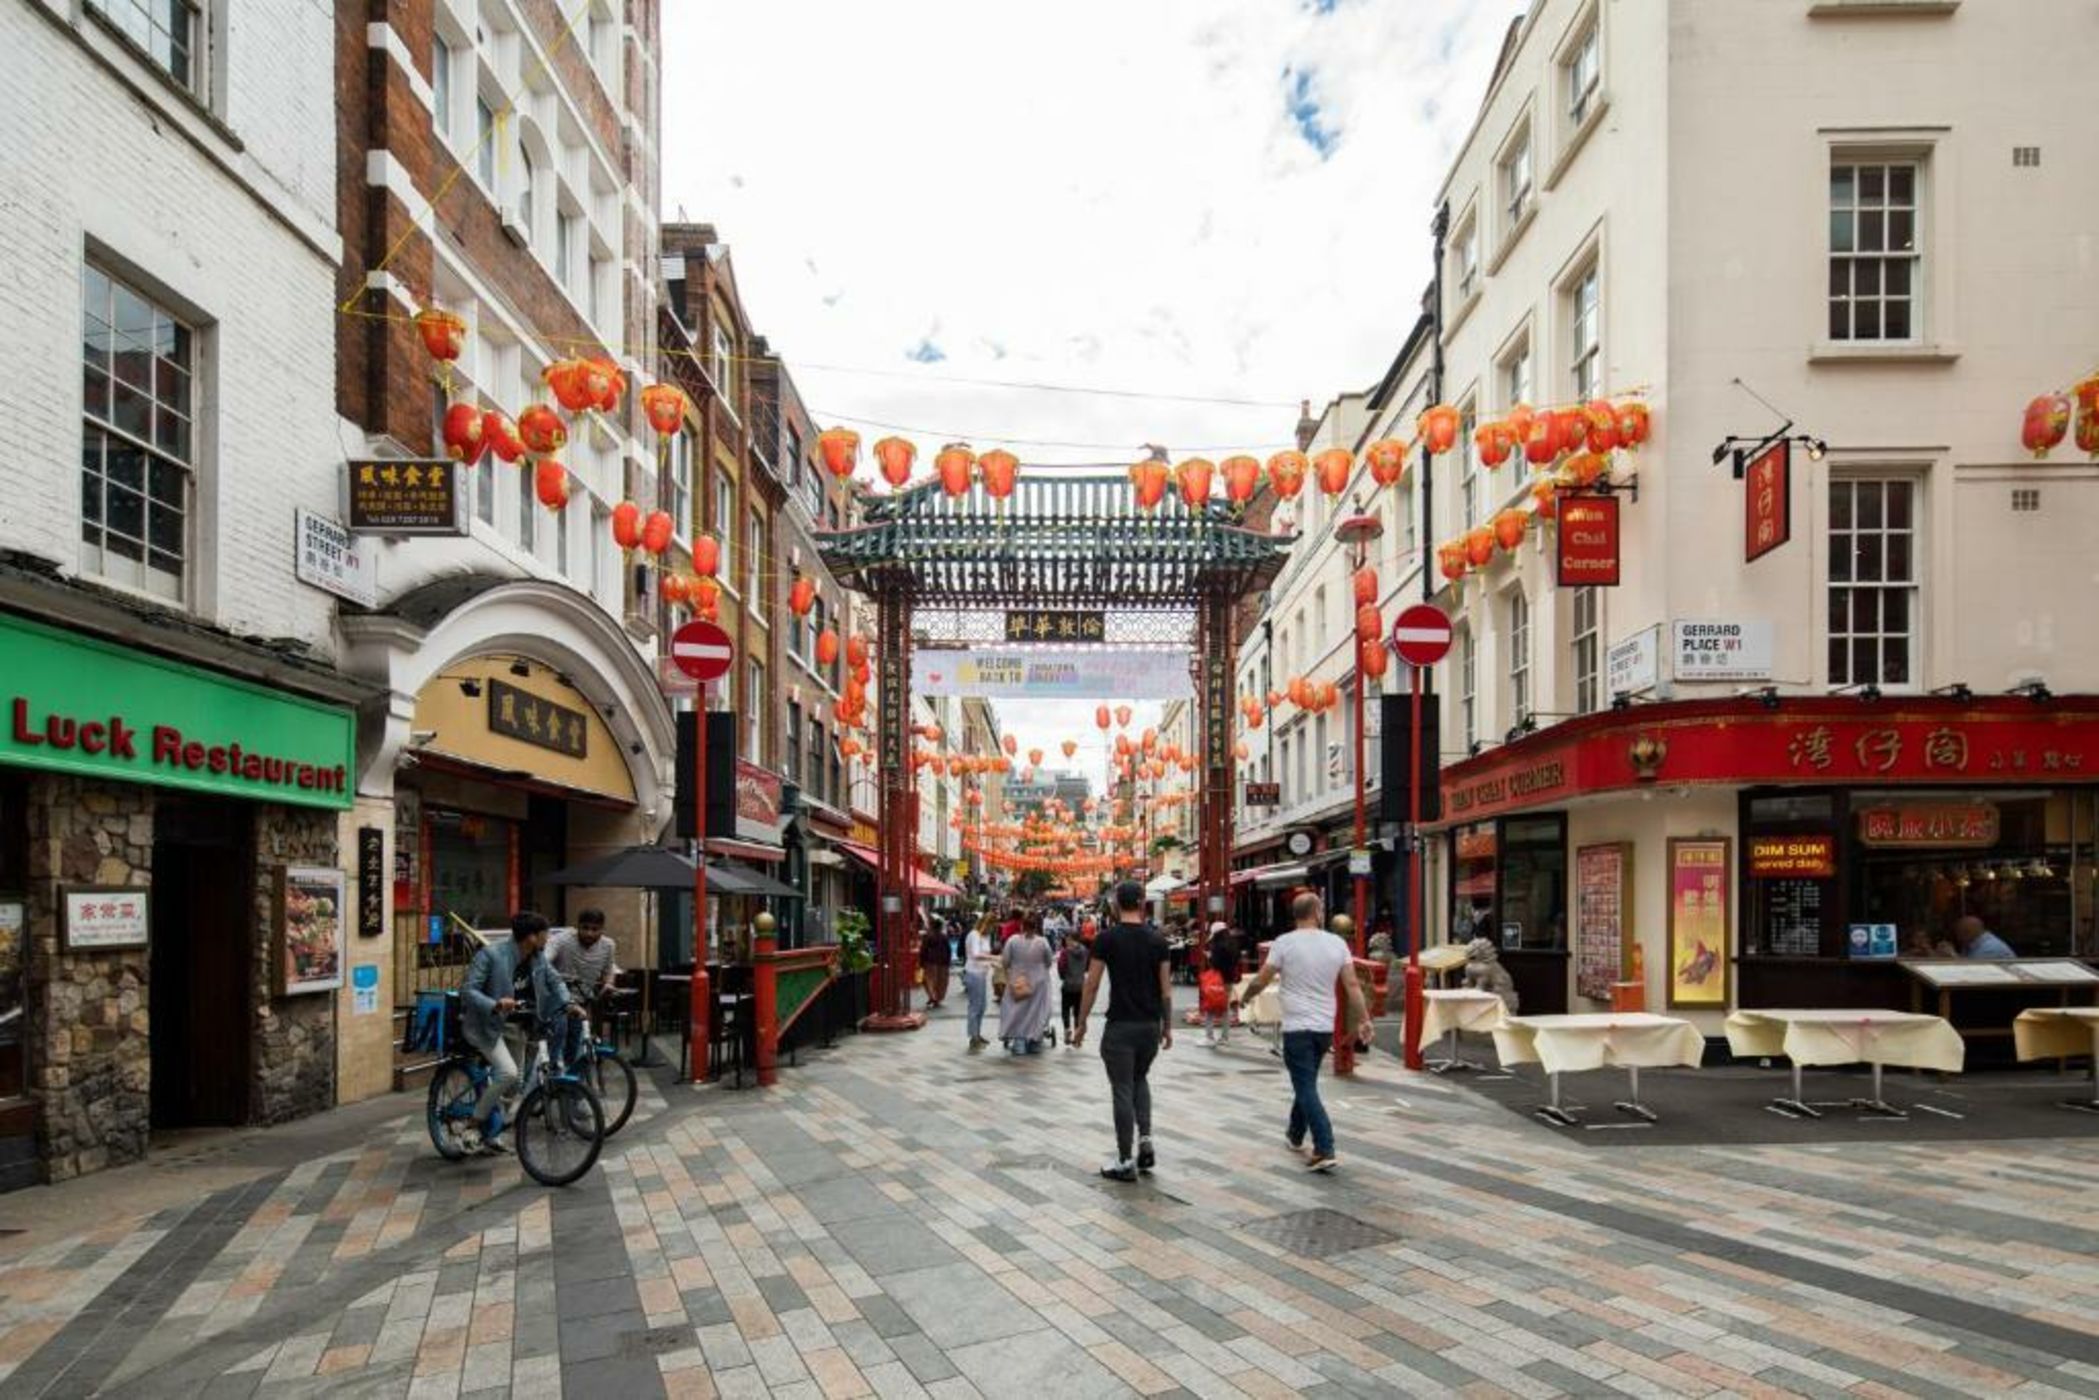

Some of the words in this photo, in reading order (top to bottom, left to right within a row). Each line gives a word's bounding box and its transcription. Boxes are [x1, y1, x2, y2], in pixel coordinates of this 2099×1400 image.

[305, 533, 343, 563] STREET
[1683, 624, 1741, 637] GERRARD
[1683, 638, 1720, 651] PLACE
[1723, 638, 1742, 651] W1
[12, 697, 137, 759] Luck
[153, 725, 347, 792] Restaurant
[1753, 844, 1784, 857] DIM
[1788, 843, 1826, 856] SUM
